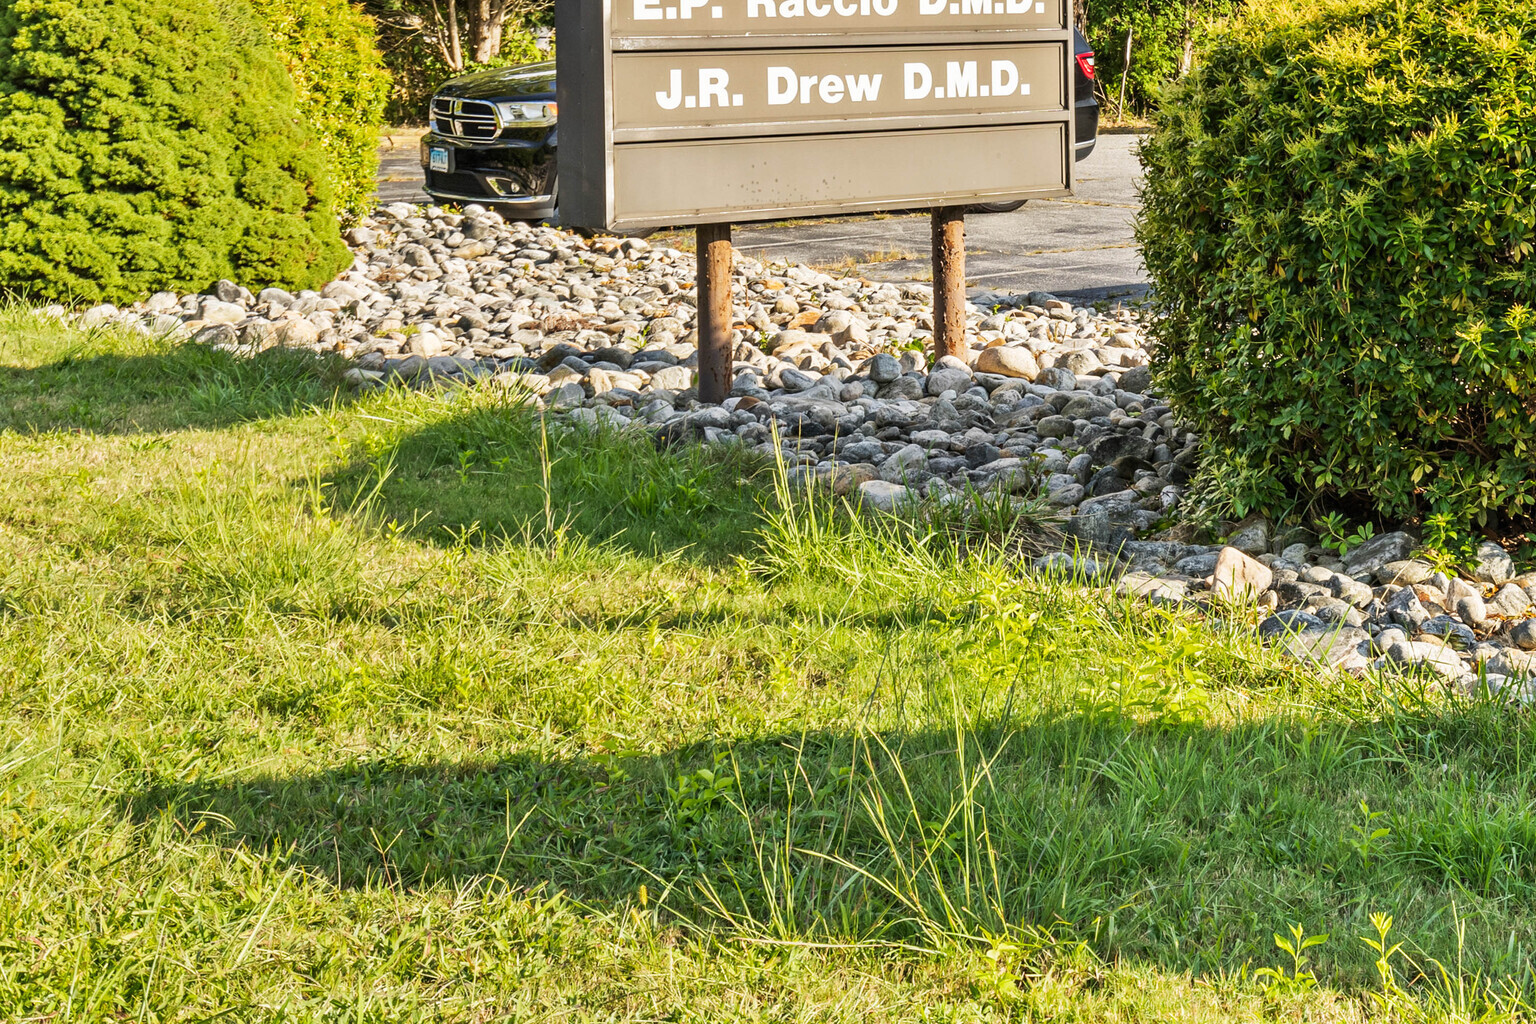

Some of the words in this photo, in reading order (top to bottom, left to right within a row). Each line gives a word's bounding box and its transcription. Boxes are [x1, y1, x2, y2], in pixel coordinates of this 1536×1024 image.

[655, 68, 744, 111] J.R.
[766, 65, 884, 106] Drew
[902, 59, 1032, 101] D.M.D.
